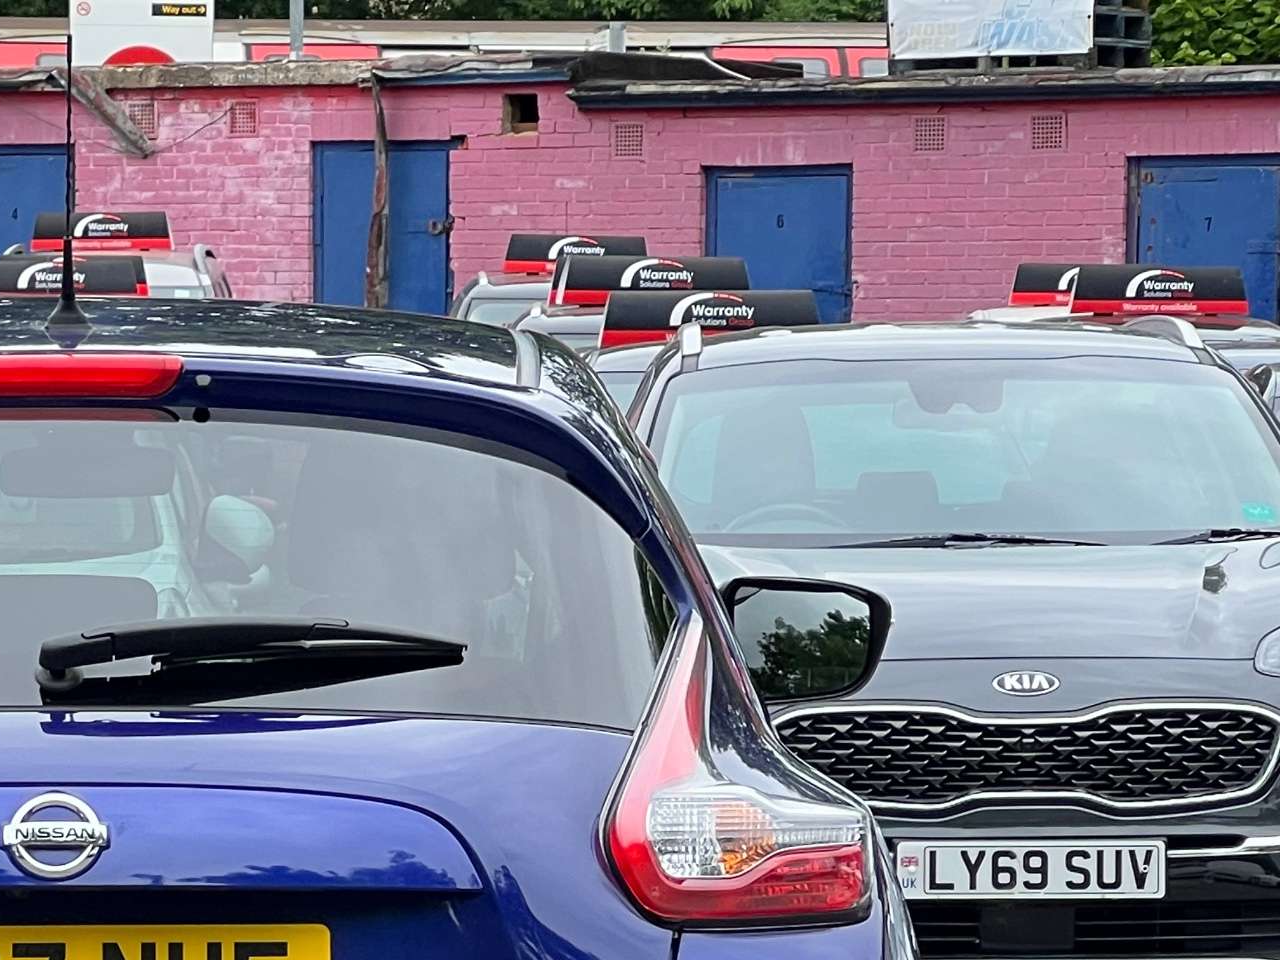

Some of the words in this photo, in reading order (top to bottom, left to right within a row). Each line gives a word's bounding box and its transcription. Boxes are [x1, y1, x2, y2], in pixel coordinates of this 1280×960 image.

[161, 5, 180, 15] Way
[181, 6, 197, 14] out
[11, 207, 18, 220] 4
[87, 222, 128, 232] Warranty
[776, 214, 785, 229] 6
[1204, 216, 1213, 232] 7
[563, 245, 606, 257] Warranty
[35, 271, 86, 283] Warrty
[639, 269, 694, 283] Warranty
[1143, 280, 1194, 292] Warranty
[691, 304, 754, 319] Warranty
[1122, 302, 1160, 312] Warranty
[1160, 301, 1198, 311] available
[1004, 674, 1050, 690] KIA
[15, 827, 95, 840] NISSAN
[928, 849, 1049, 891] LY69
[1064, 849, 1154, 890] SUV
[902, 878, 918, 889] UK
